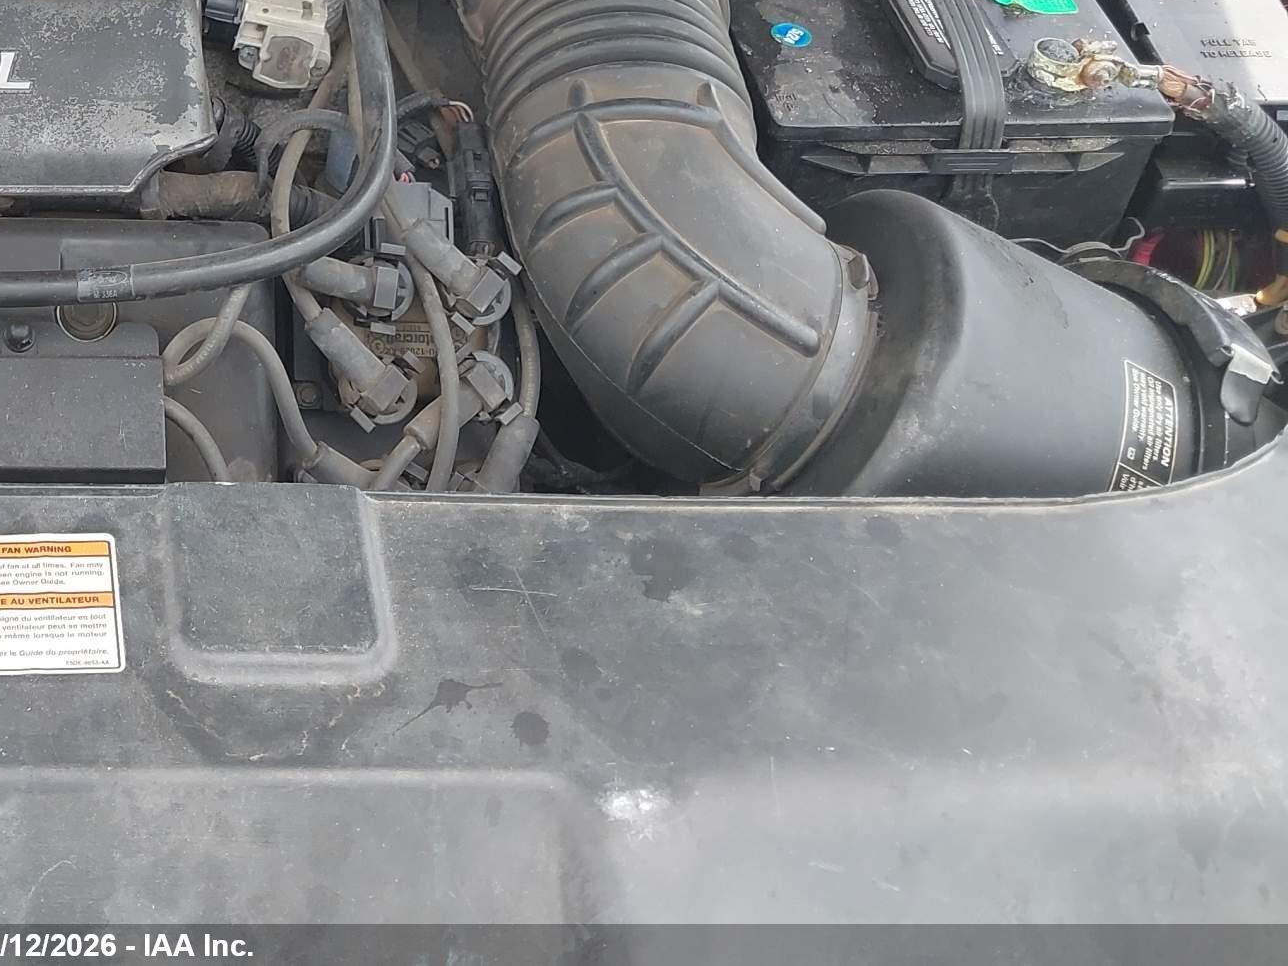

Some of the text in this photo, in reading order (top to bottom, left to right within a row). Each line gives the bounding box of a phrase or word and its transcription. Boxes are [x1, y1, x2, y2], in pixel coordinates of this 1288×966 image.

[1200, 39, 1257, 47] PULL TAB
[1200, 50, 1273, 58] TO RELEASE
[1161, 395, 1174, 467] ATTENTION
[1142, 447, 1153, 470] filters
[2, 545, 72, 554] FAN WARNING
[71, 569, 105, 577] running.
[12, 597, 25, 605] AU
[28, 596, 100, 605] VENTILATEUR
[33, 631, 65, 639] lorsque
[18, 649, 44, 657] Guide
